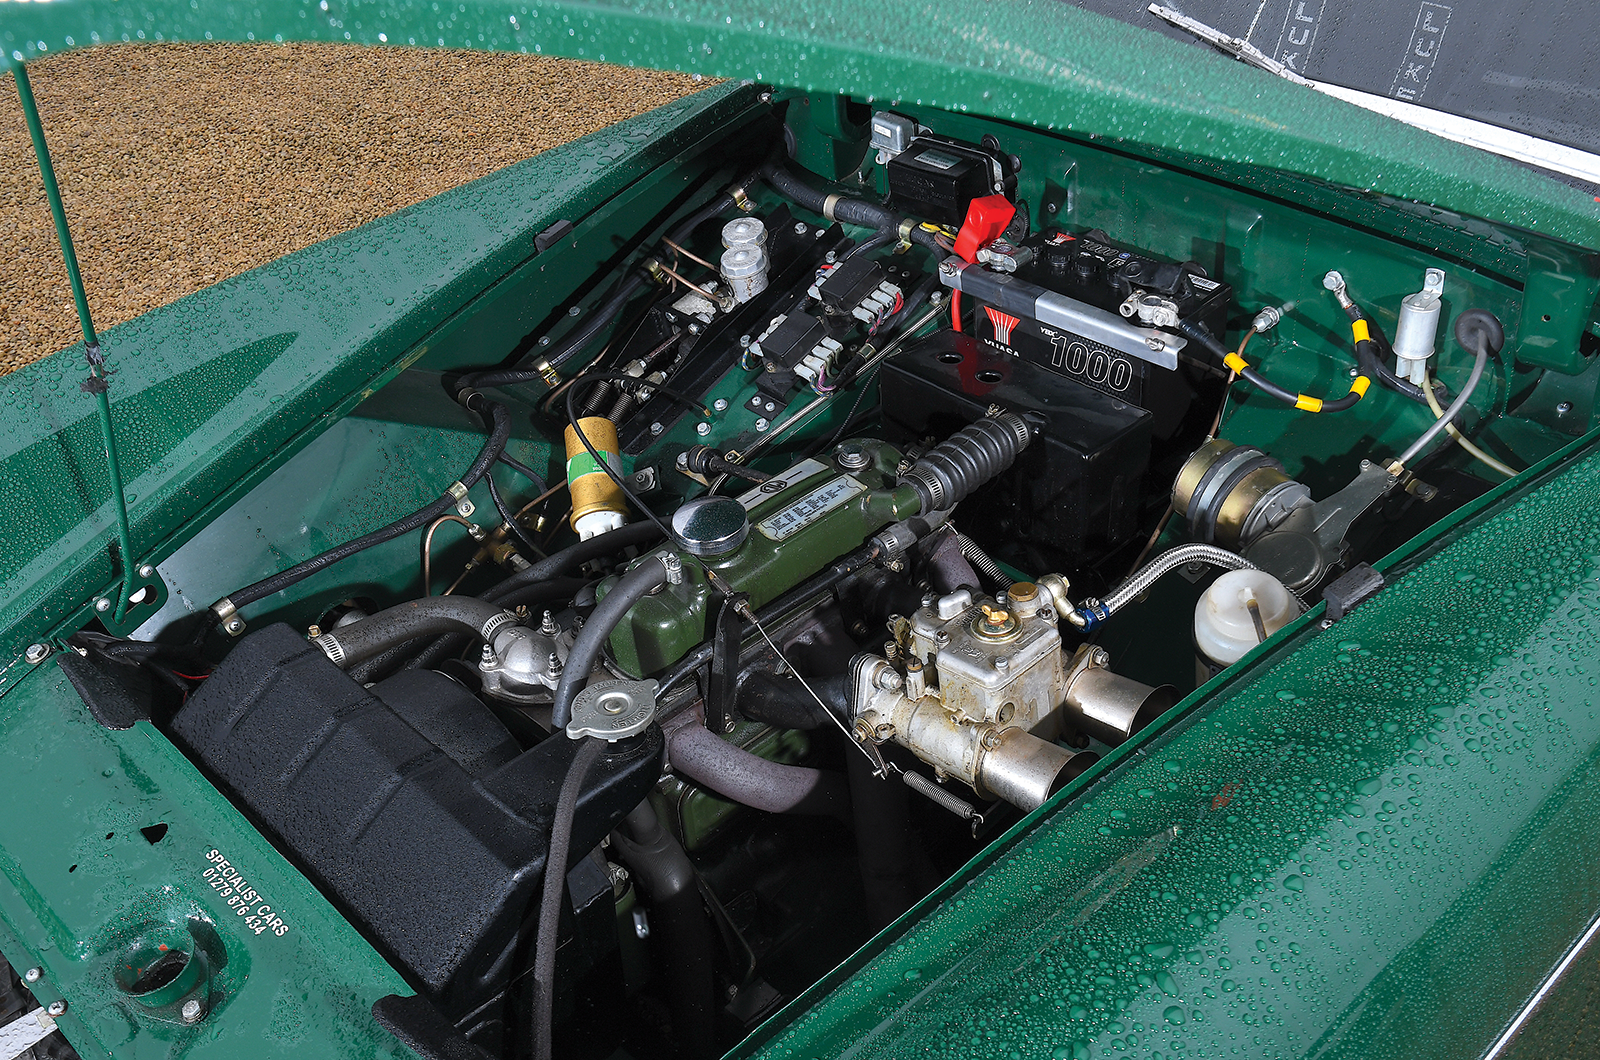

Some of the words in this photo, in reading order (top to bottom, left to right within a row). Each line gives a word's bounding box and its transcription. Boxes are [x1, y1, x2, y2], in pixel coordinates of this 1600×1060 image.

[1051, 336, 1133, 391] 1000
[202, 867, 234, 898] 01279
[227, 895, 250, 916] 876
[244, 914, 267, 935] 434
[205, 849, 264, 906] SPECIALIST
[257, 904, 289, 937] CARS
